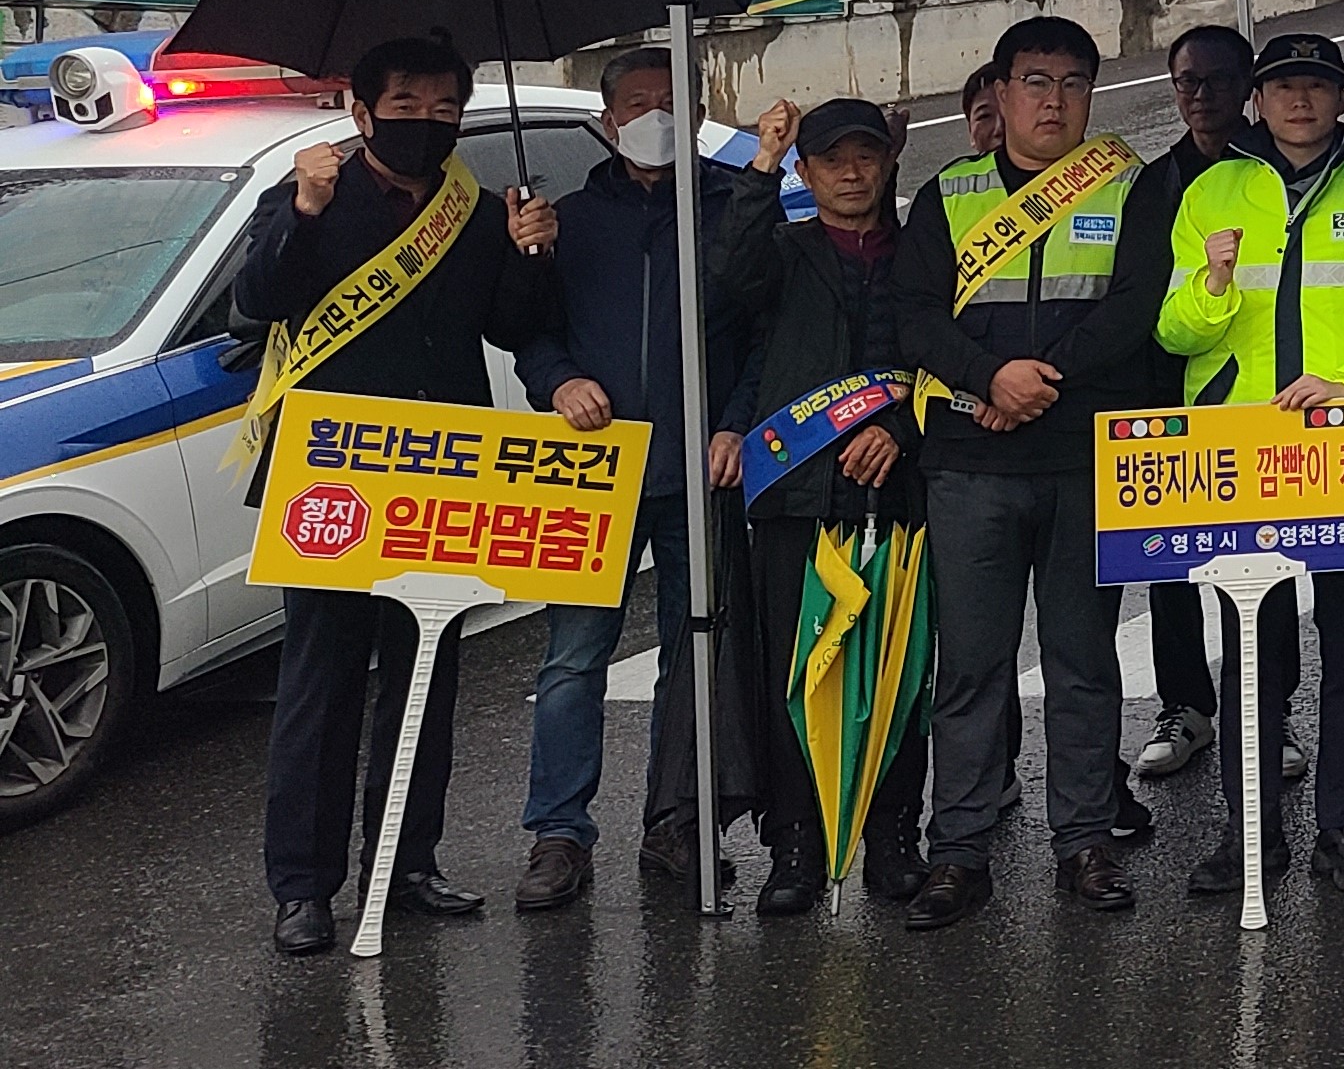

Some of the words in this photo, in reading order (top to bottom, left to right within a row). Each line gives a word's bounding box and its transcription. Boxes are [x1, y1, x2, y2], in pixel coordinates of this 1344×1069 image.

[1019, 139, 1133, 226] 무단횡단을
[394, 178, 471, 280] 무단횡단을
[789, 373, 869, 426] 방어보행
[833, 388, 884, 423] 서다!
[306, 418, 482, 479] 횡단보도
[494, 437, 621, 492] 무조건
[1116, 448, 1239, 508] 방향지시등
[1256, 442, 1329, 498] 깜빡이
[297, 522, 352, 546] STOP
[301, 496, 357, 525] 정지
[381, 495, 612, 573] 일단멈춤!
[1171, 531, 1237, 554] 영천시
